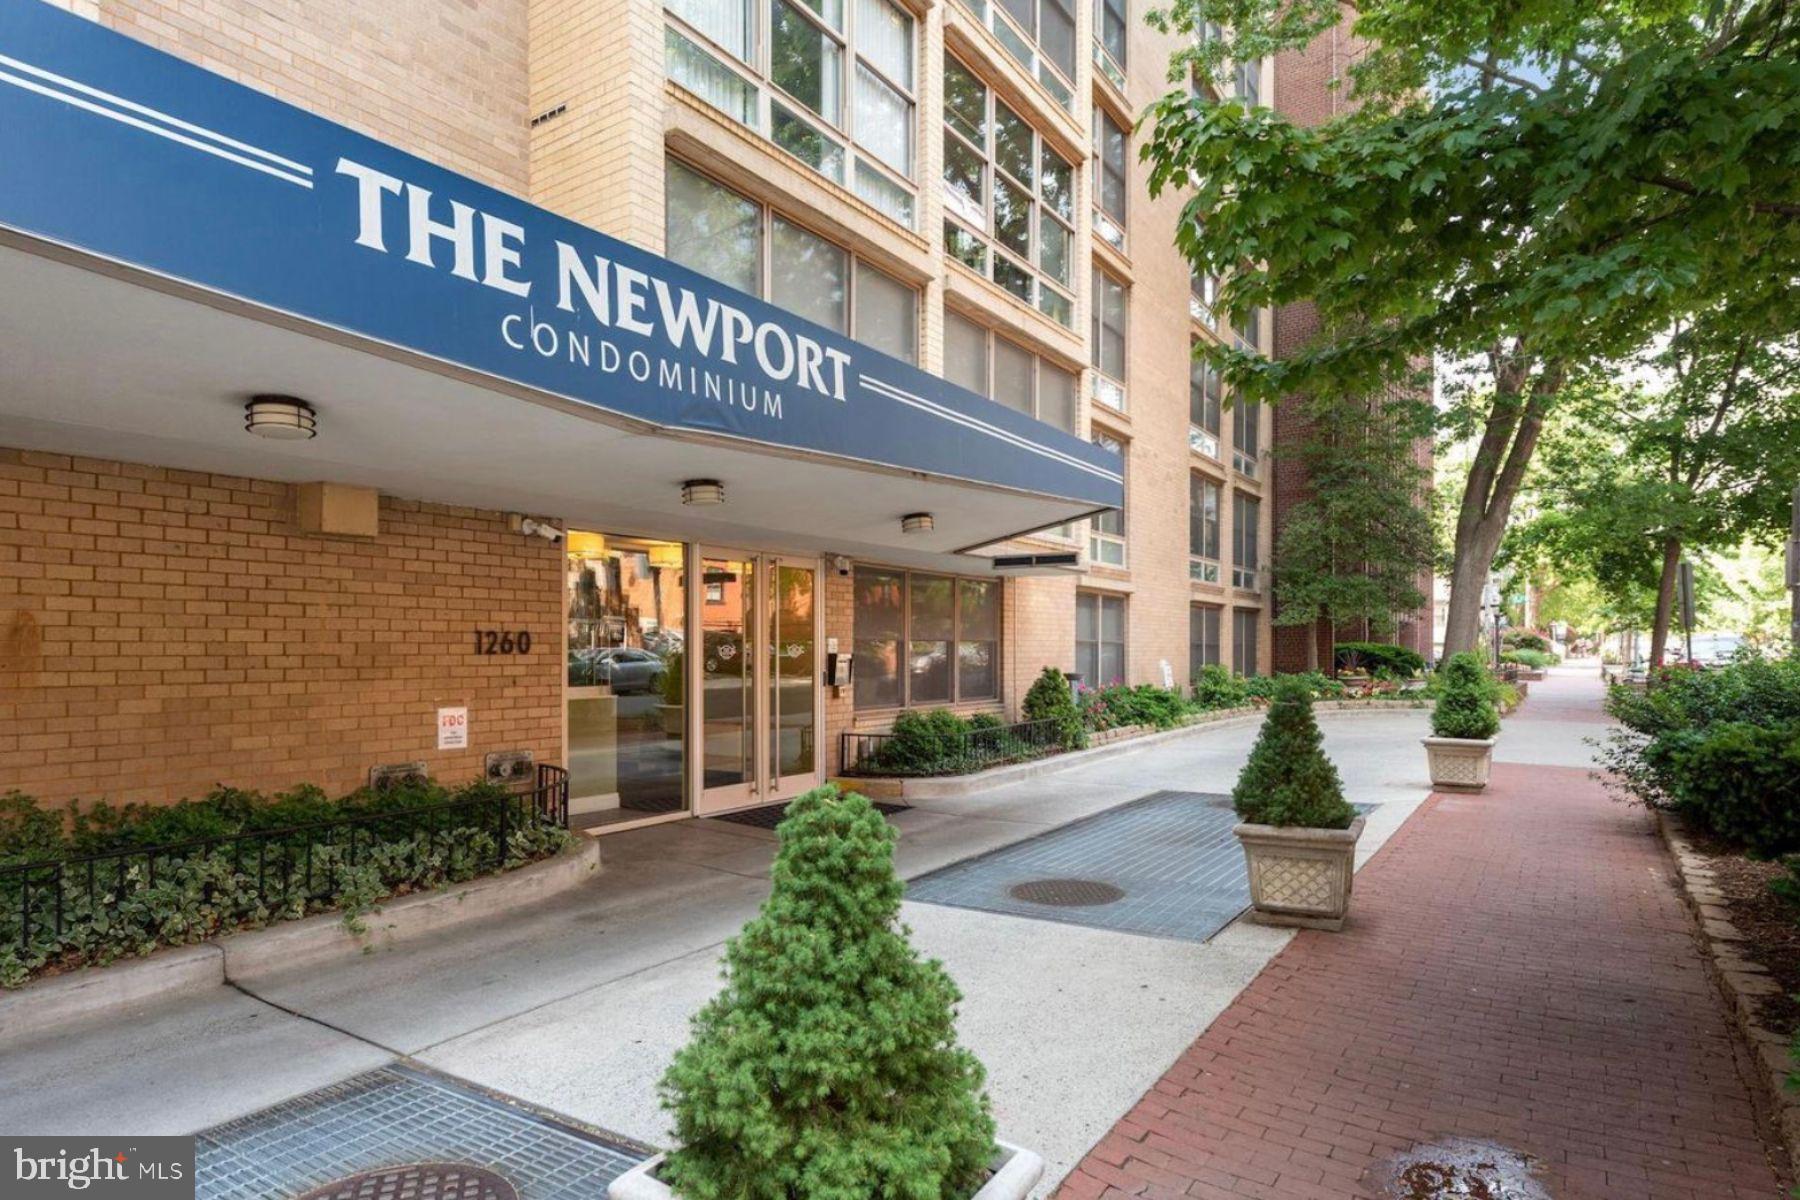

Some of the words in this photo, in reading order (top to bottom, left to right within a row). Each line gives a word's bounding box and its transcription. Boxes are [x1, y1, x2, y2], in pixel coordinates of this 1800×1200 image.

[335, 157, 532, 297] THE
[554, 239, 851, 401] NEWPORT
[500, 313, 784, 419] CONDOMINIUM
[475, 630, 531, 655] 1260
